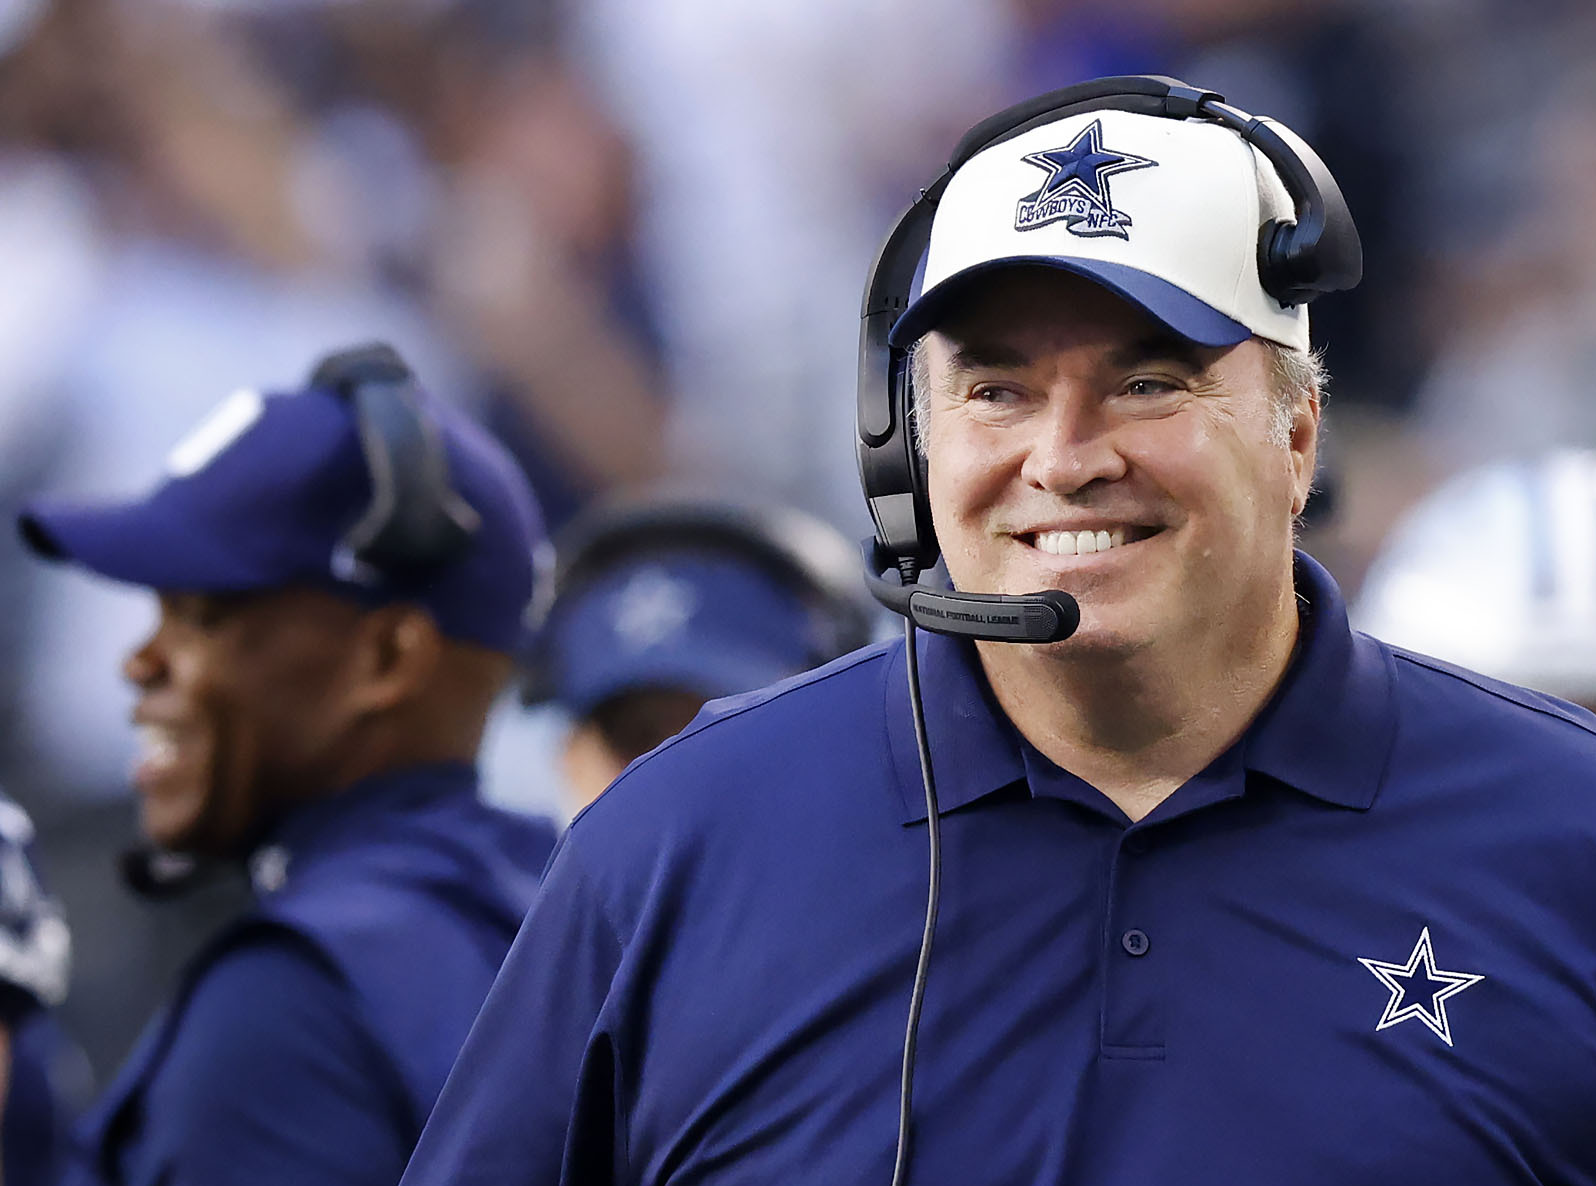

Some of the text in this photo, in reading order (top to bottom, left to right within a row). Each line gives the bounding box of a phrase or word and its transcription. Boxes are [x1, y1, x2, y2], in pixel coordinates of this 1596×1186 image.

[1019, 200, 1086, 224] COWBOYS
[946, 611, 985, 624] FOOTBALL
[987, 615, 1020, 625] LEAGUE
